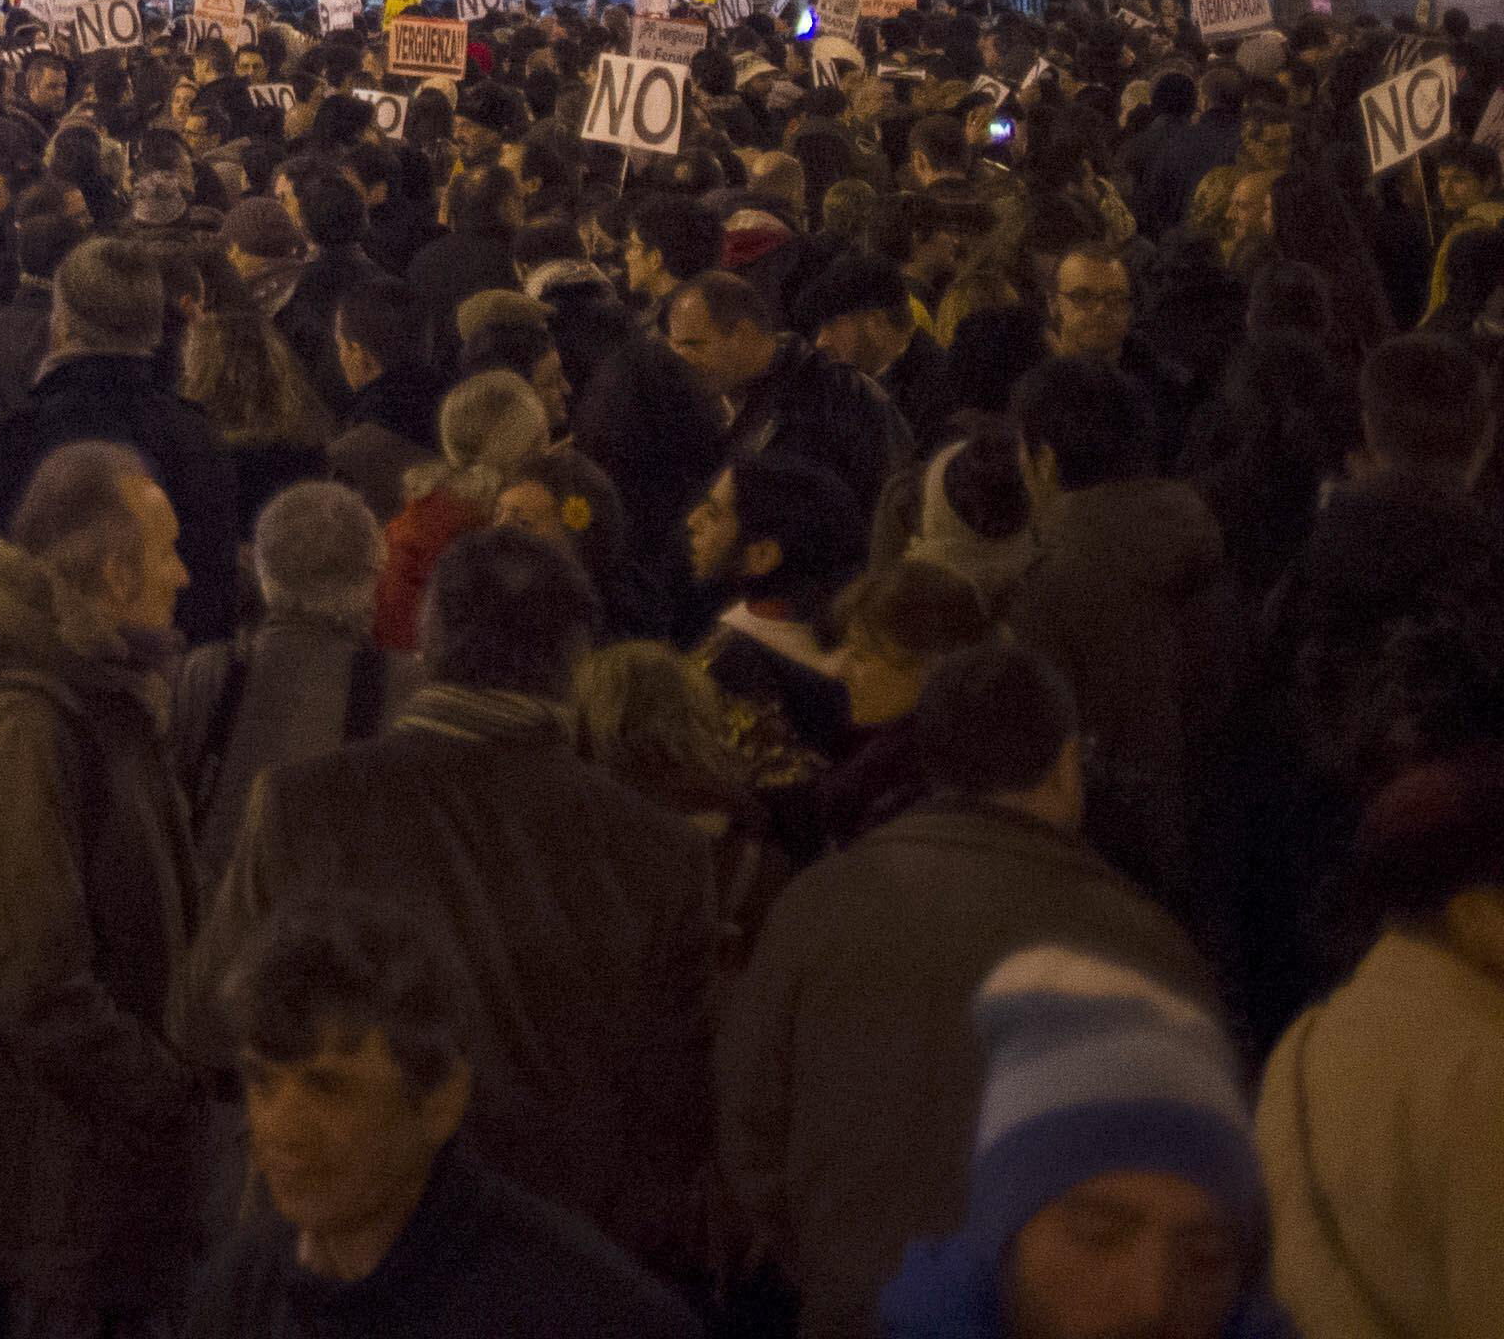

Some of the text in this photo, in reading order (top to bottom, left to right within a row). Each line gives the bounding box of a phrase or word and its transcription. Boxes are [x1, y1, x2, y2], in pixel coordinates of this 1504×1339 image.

[76, 0, 139, 48] NO
[253, 85, 296, 109] NO
[587, 59, 679, 145] NO
[1364, 68, 1446, 167] NO
